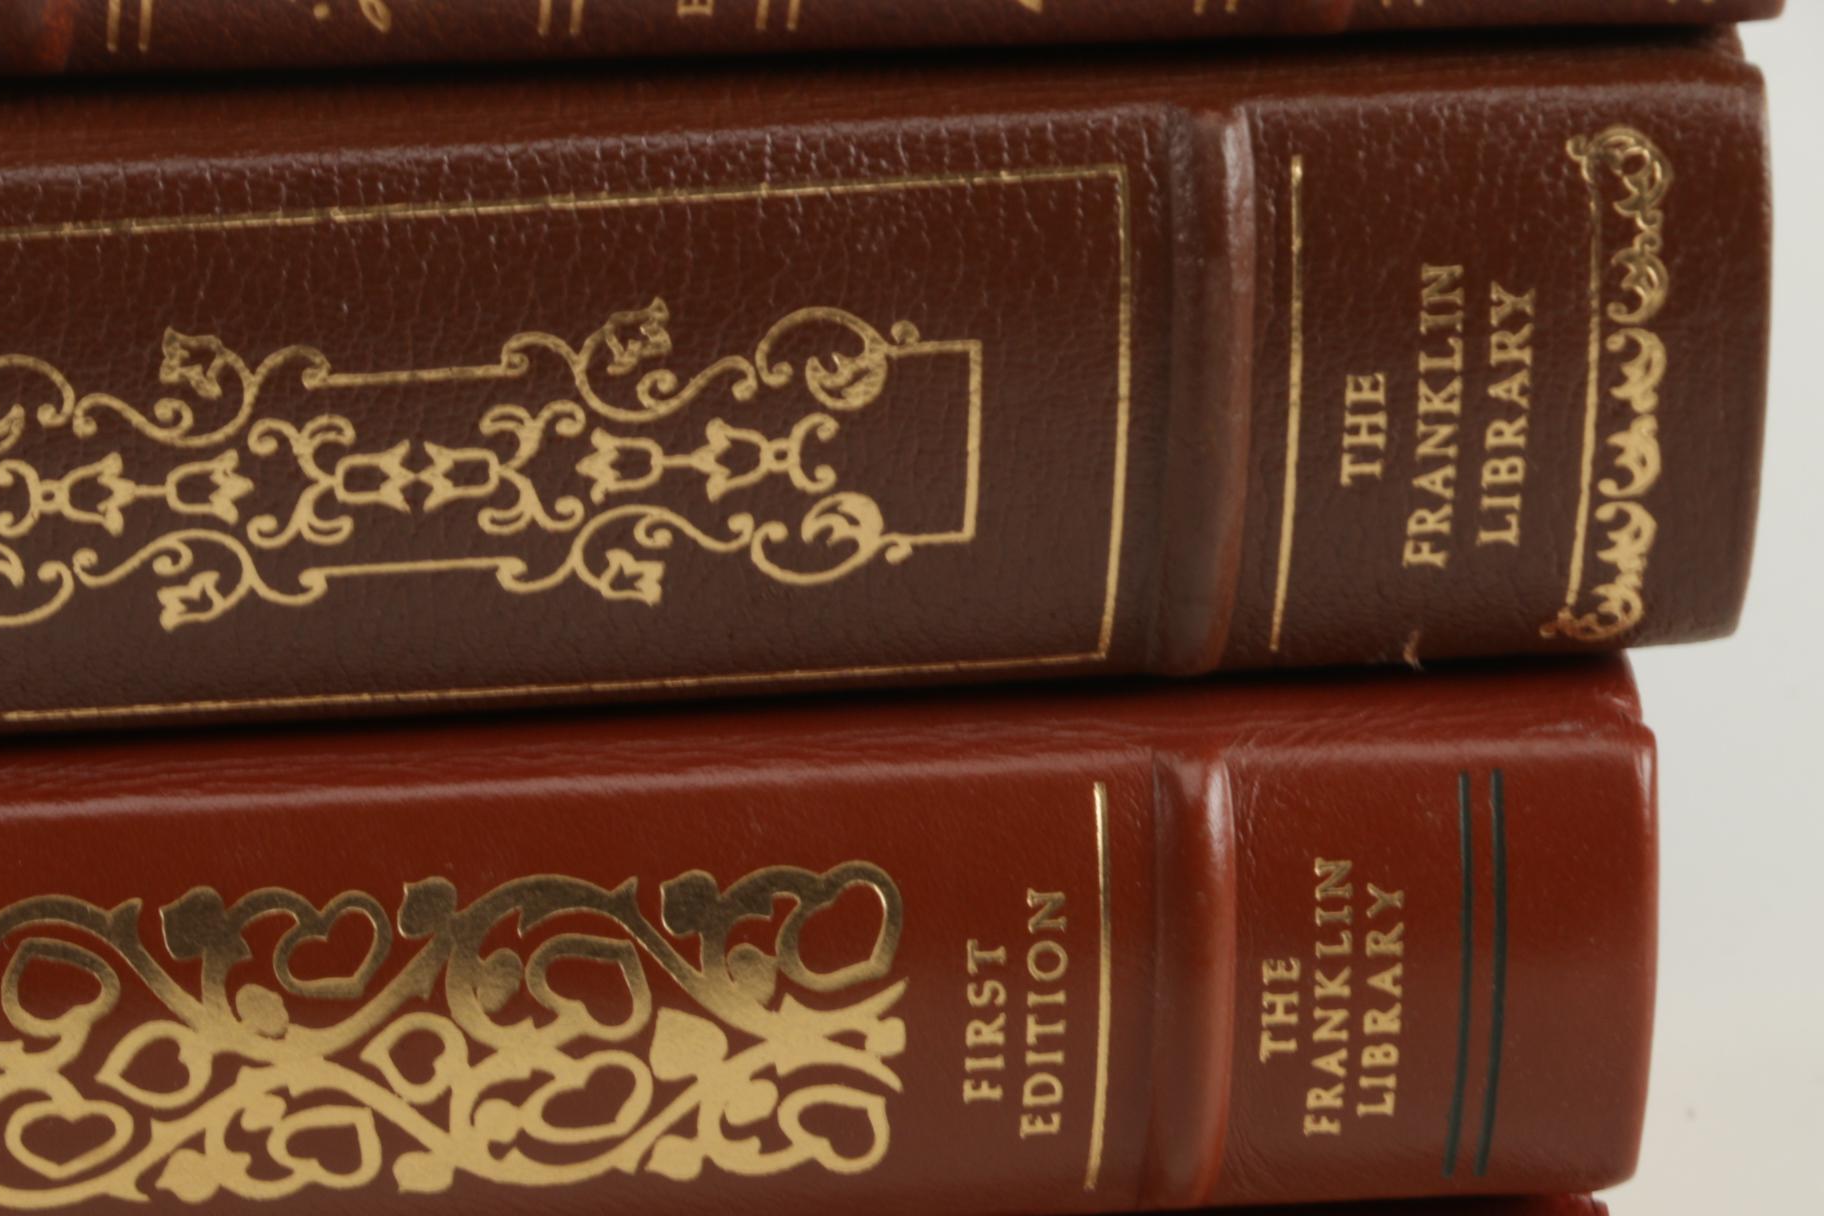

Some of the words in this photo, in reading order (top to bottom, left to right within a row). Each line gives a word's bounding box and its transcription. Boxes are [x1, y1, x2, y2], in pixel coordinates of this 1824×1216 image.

[1339, 372, 1388, 487] THE
[1401, 263, 1464, 569] FRANKLIN
[1476, 281, 1535, 547] LIBRARY
[962, 939, 1007, 1104] FIRST
[1019, 887, 1069, 1139] EDITION
[1258, 957, 1301, 1063] THE
[1302, 856, 1353, 1137] FRANKLIN
[1355, 882, 1405, 1118] LIBRARY
